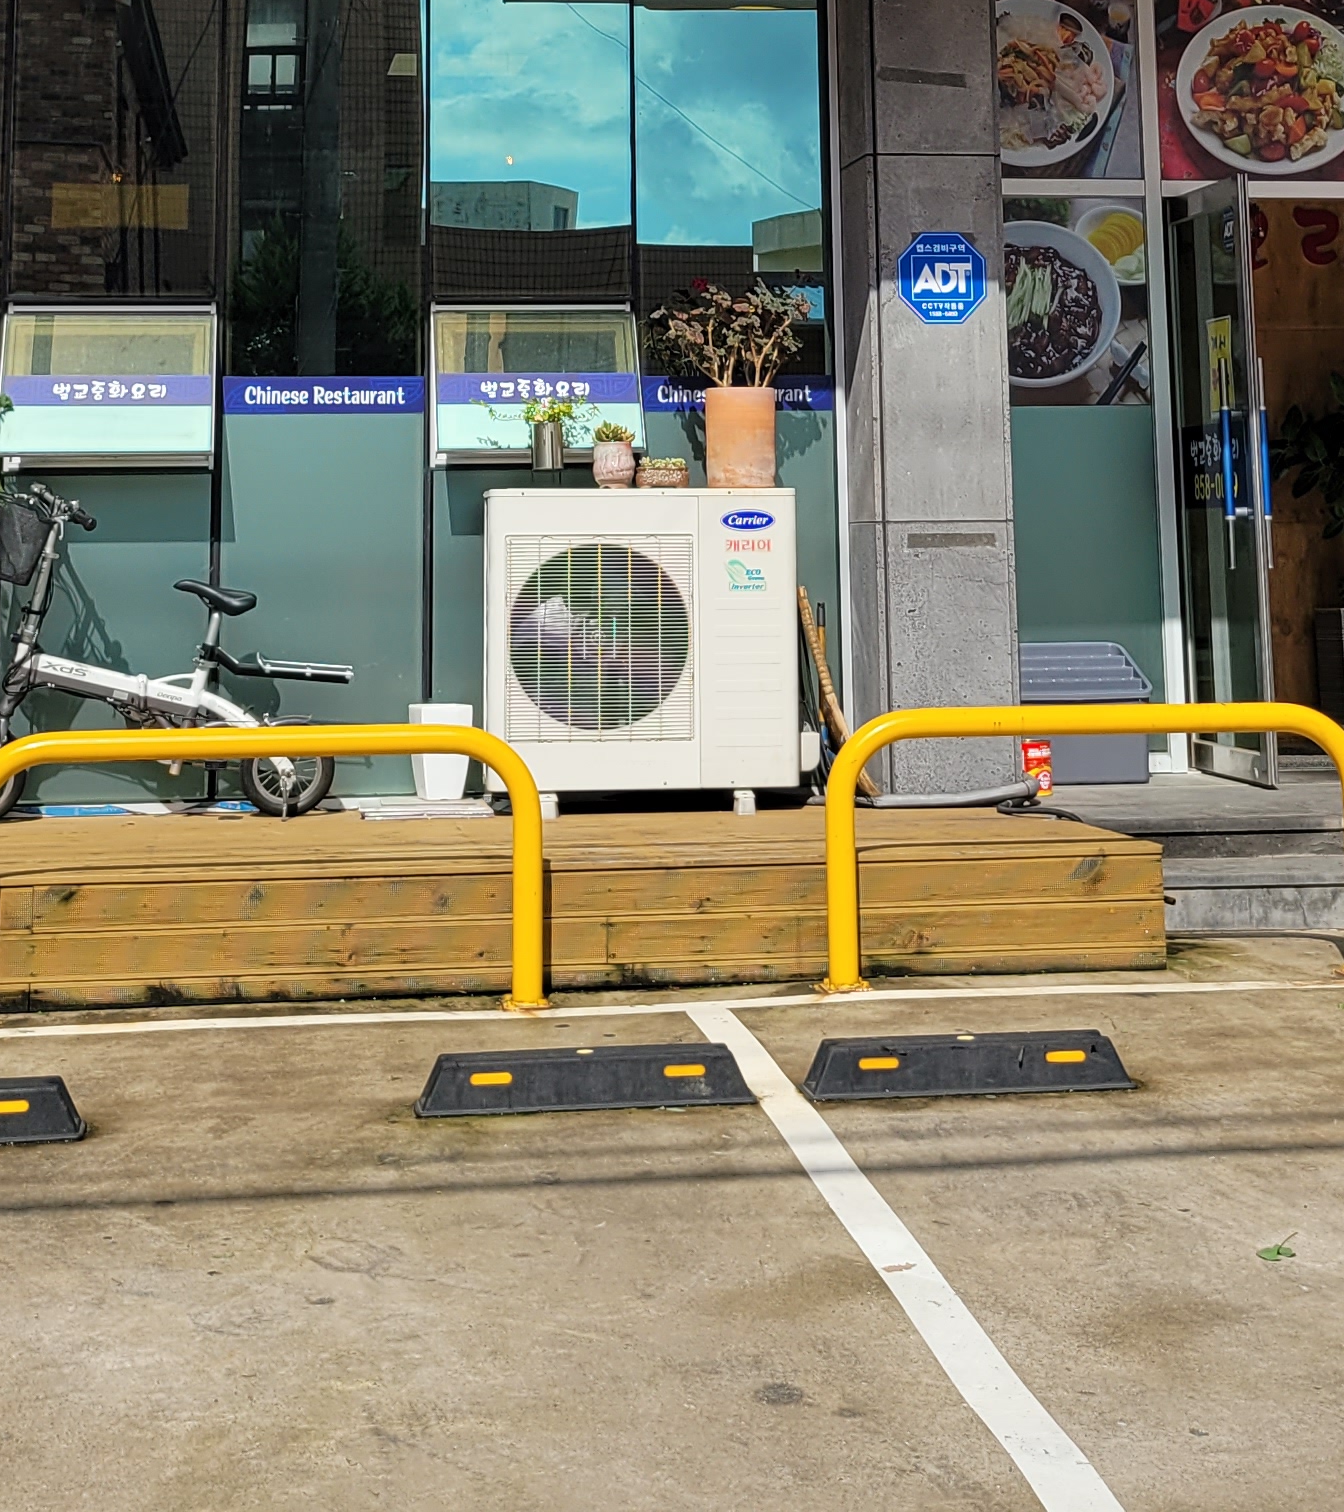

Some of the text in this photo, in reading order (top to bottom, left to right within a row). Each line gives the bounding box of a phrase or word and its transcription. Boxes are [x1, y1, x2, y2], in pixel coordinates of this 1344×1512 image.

[913, 262, 972, 294] ADT
[244, 385, 406, 406] Chinese Restaurant
[657, 384, 707, 404] Chines
[1189, 432, 1240, 468] 벌교중화리
[727, 514, 769, 526] Carrier
[725, 538, 772, 552] 캐리어
